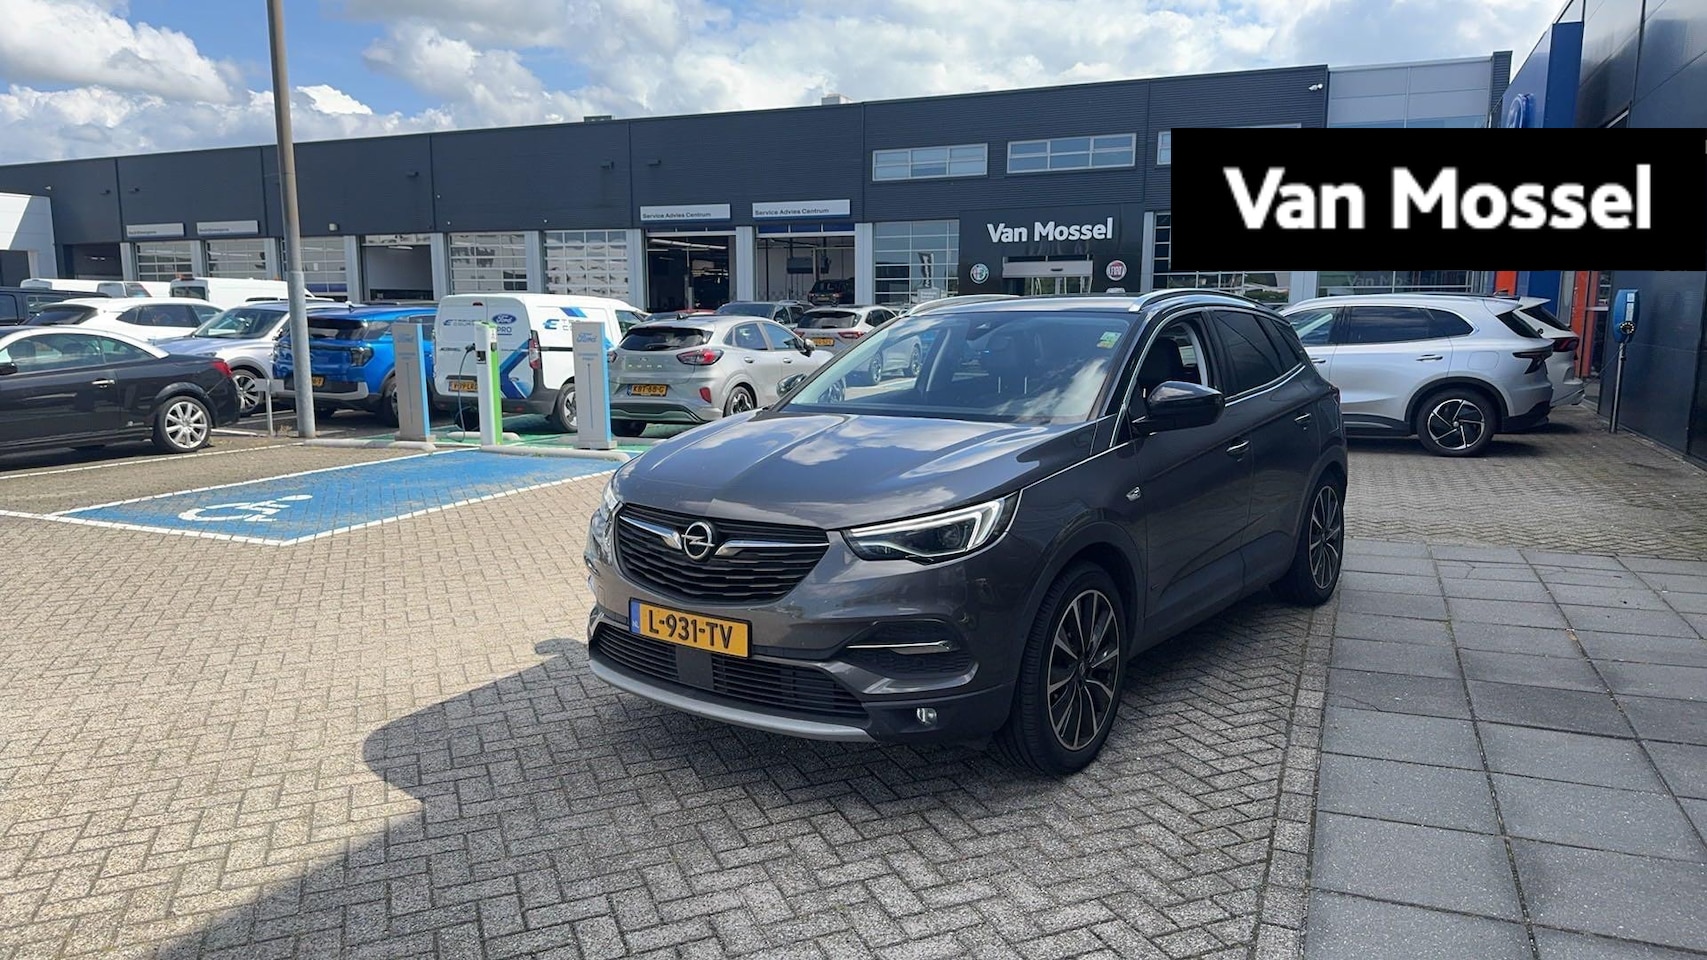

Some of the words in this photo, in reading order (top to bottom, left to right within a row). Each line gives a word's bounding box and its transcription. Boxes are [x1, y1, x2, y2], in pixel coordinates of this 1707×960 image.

[986, 223, 1028, 242] Van
[1034, 217, 1113, 241] Mossel
[648, 609, 733, 649] L-931-TV
